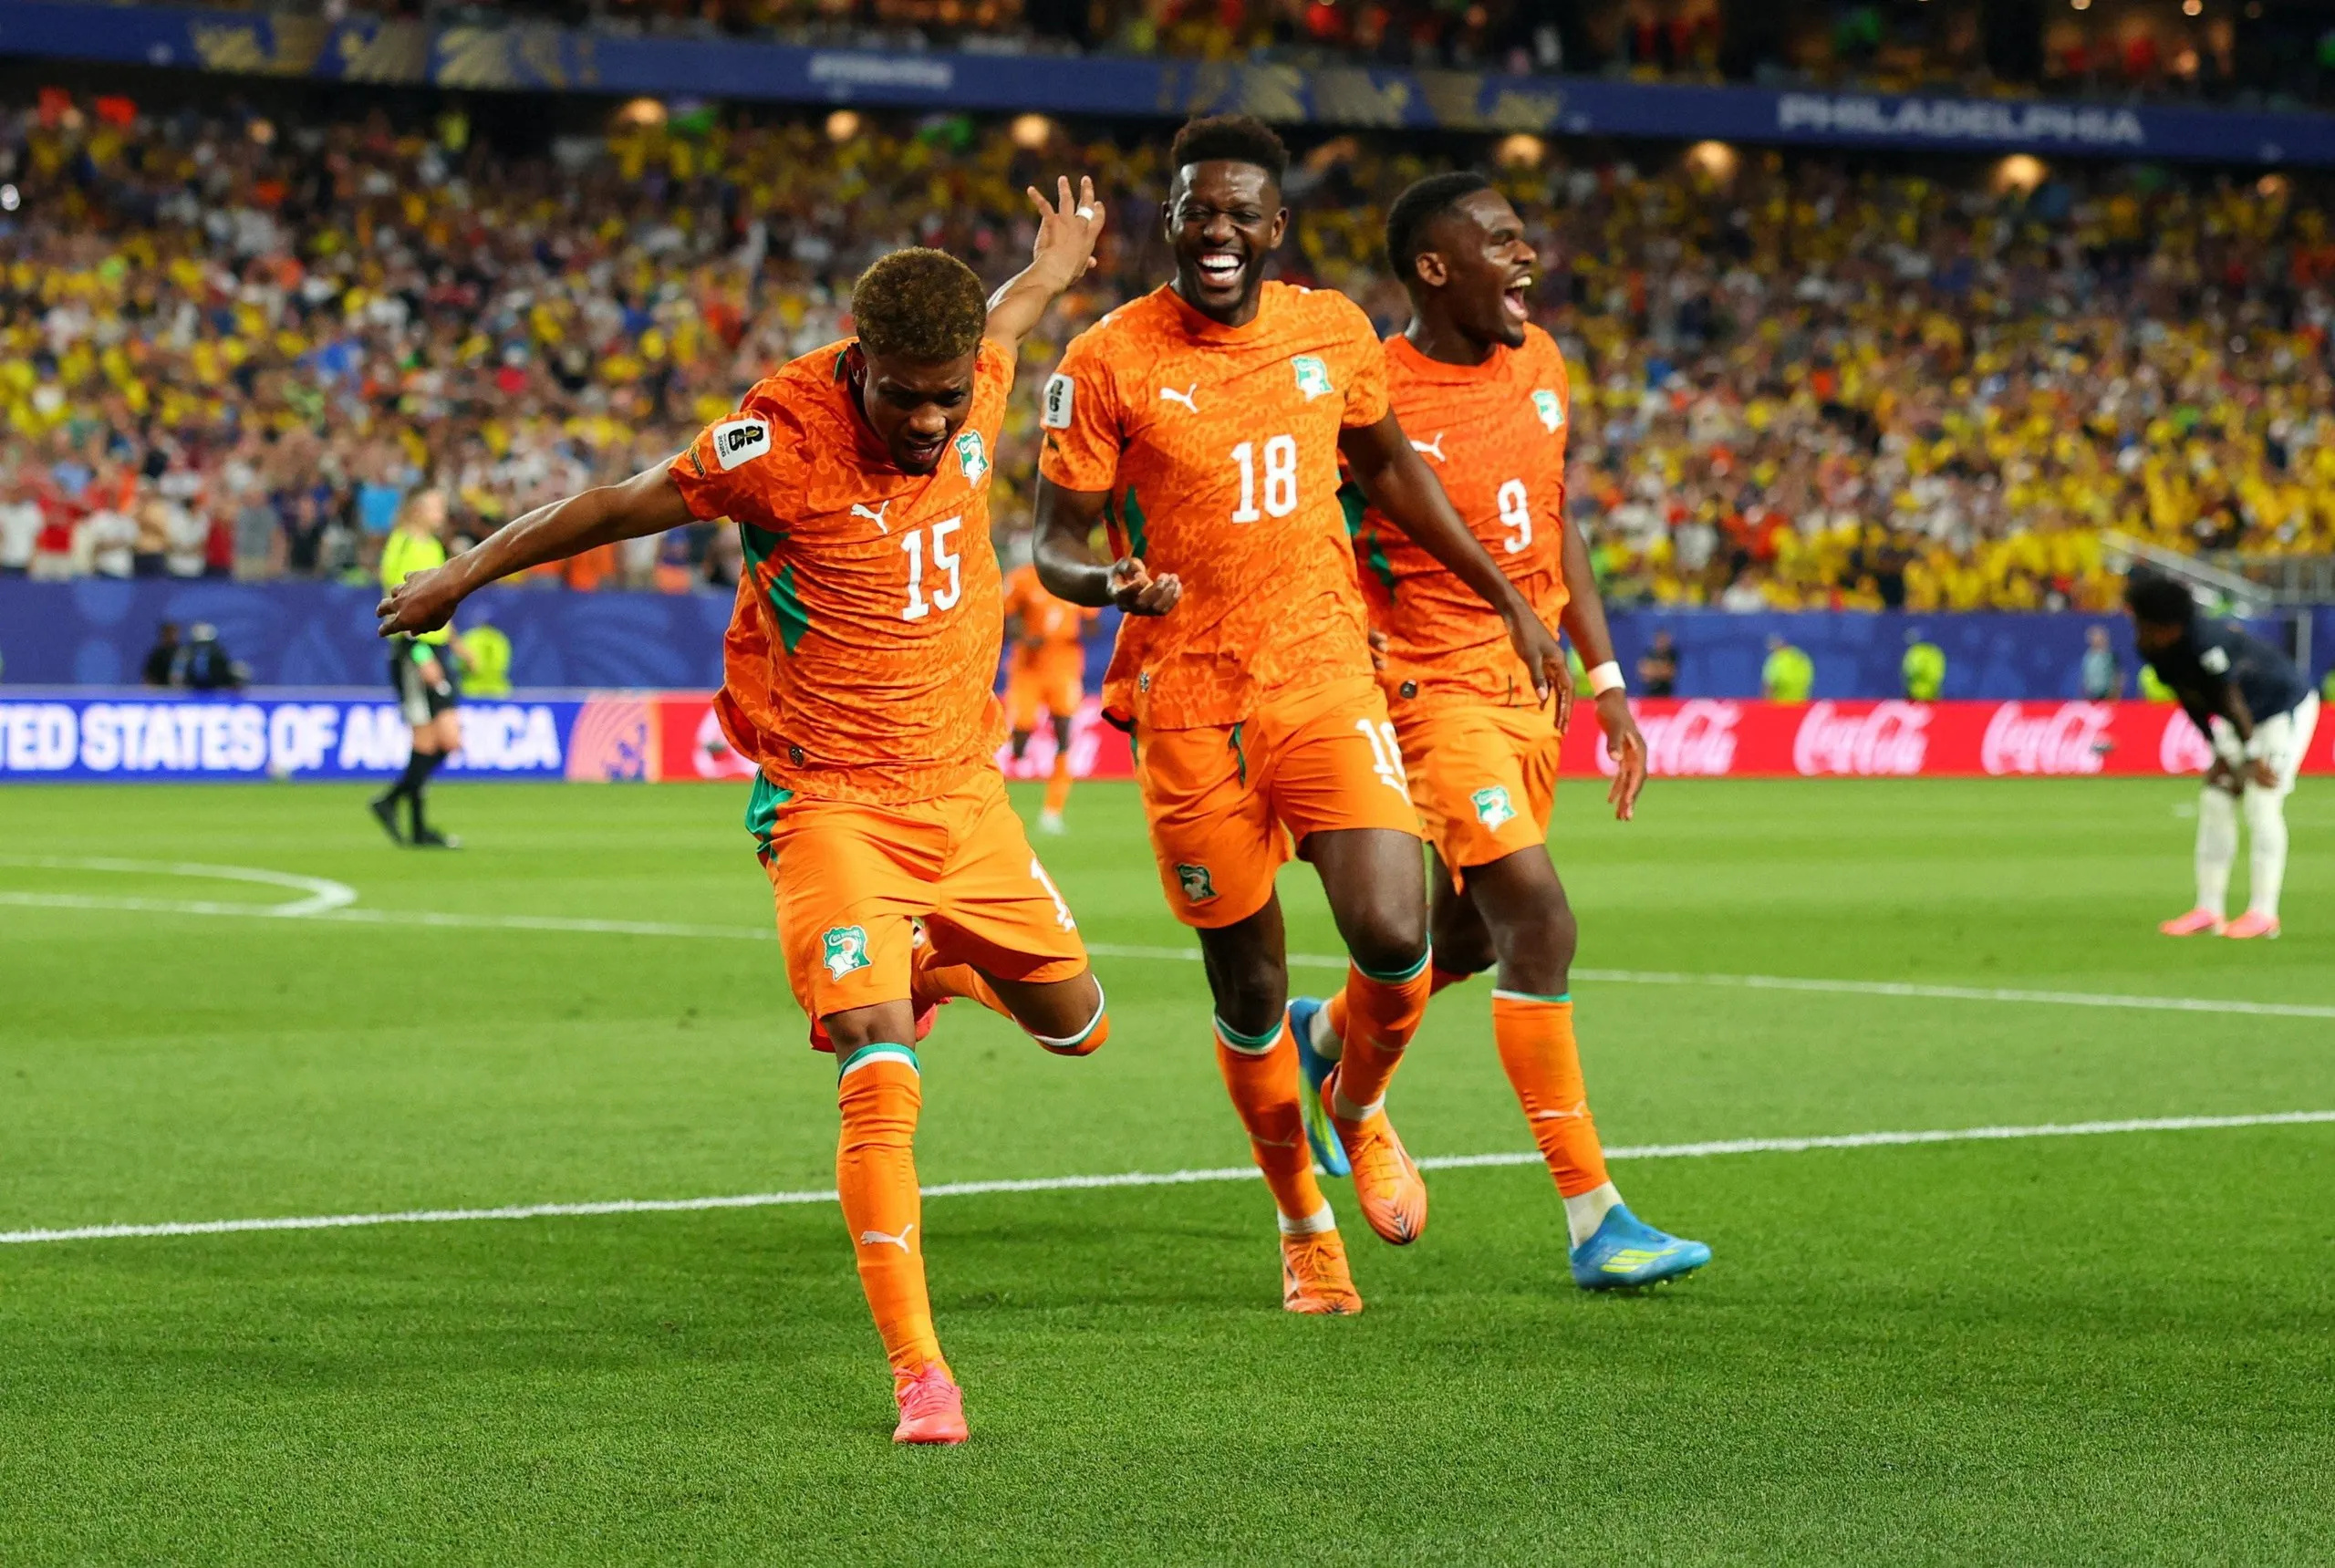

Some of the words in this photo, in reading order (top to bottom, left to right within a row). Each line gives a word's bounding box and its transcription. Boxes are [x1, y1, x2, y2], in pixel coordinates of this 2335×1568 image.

[1779, 93, 2144, 146] PHILADELPHIA
[717, 435, 727, 458] 2026
[1230, 433, 1298, 524] 18
[1497, 477, 1532, 555] 9
[900, 514, 962, 621] 15
[79, 702, 268, 772] STATES
[269, 703, 339, 771] OF
